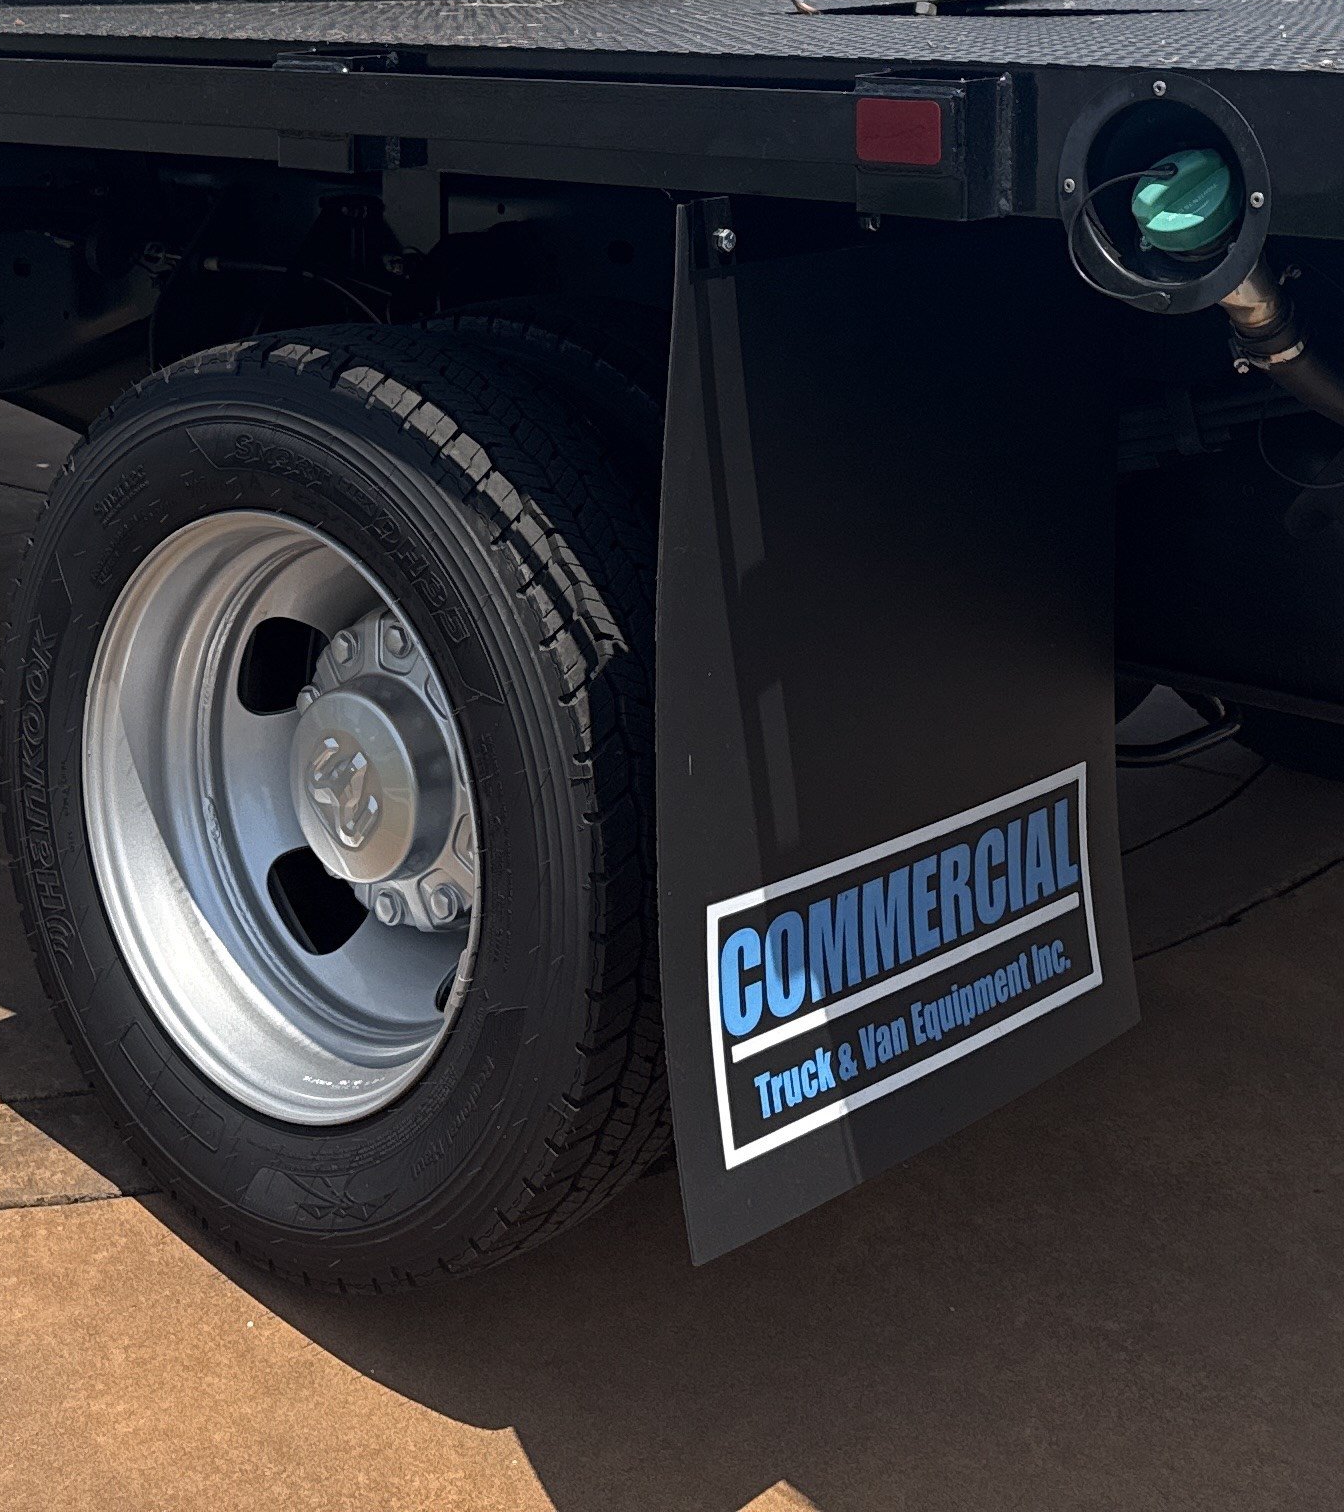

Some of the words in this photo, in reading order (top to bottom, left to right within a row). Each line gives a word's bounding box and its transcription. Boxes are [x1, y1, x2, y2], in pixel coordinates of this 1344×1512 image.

[719, 799, 1078, 1038] COMMERCIAL
[754, 1048, 837, 1118] Truck
[838, 1043, 858, 1080] &
[859, 1019, 909, 1070] Van
[911, 955, 1031, 1046] Equipment
[1031, 939, 1071, 982] Inc.
